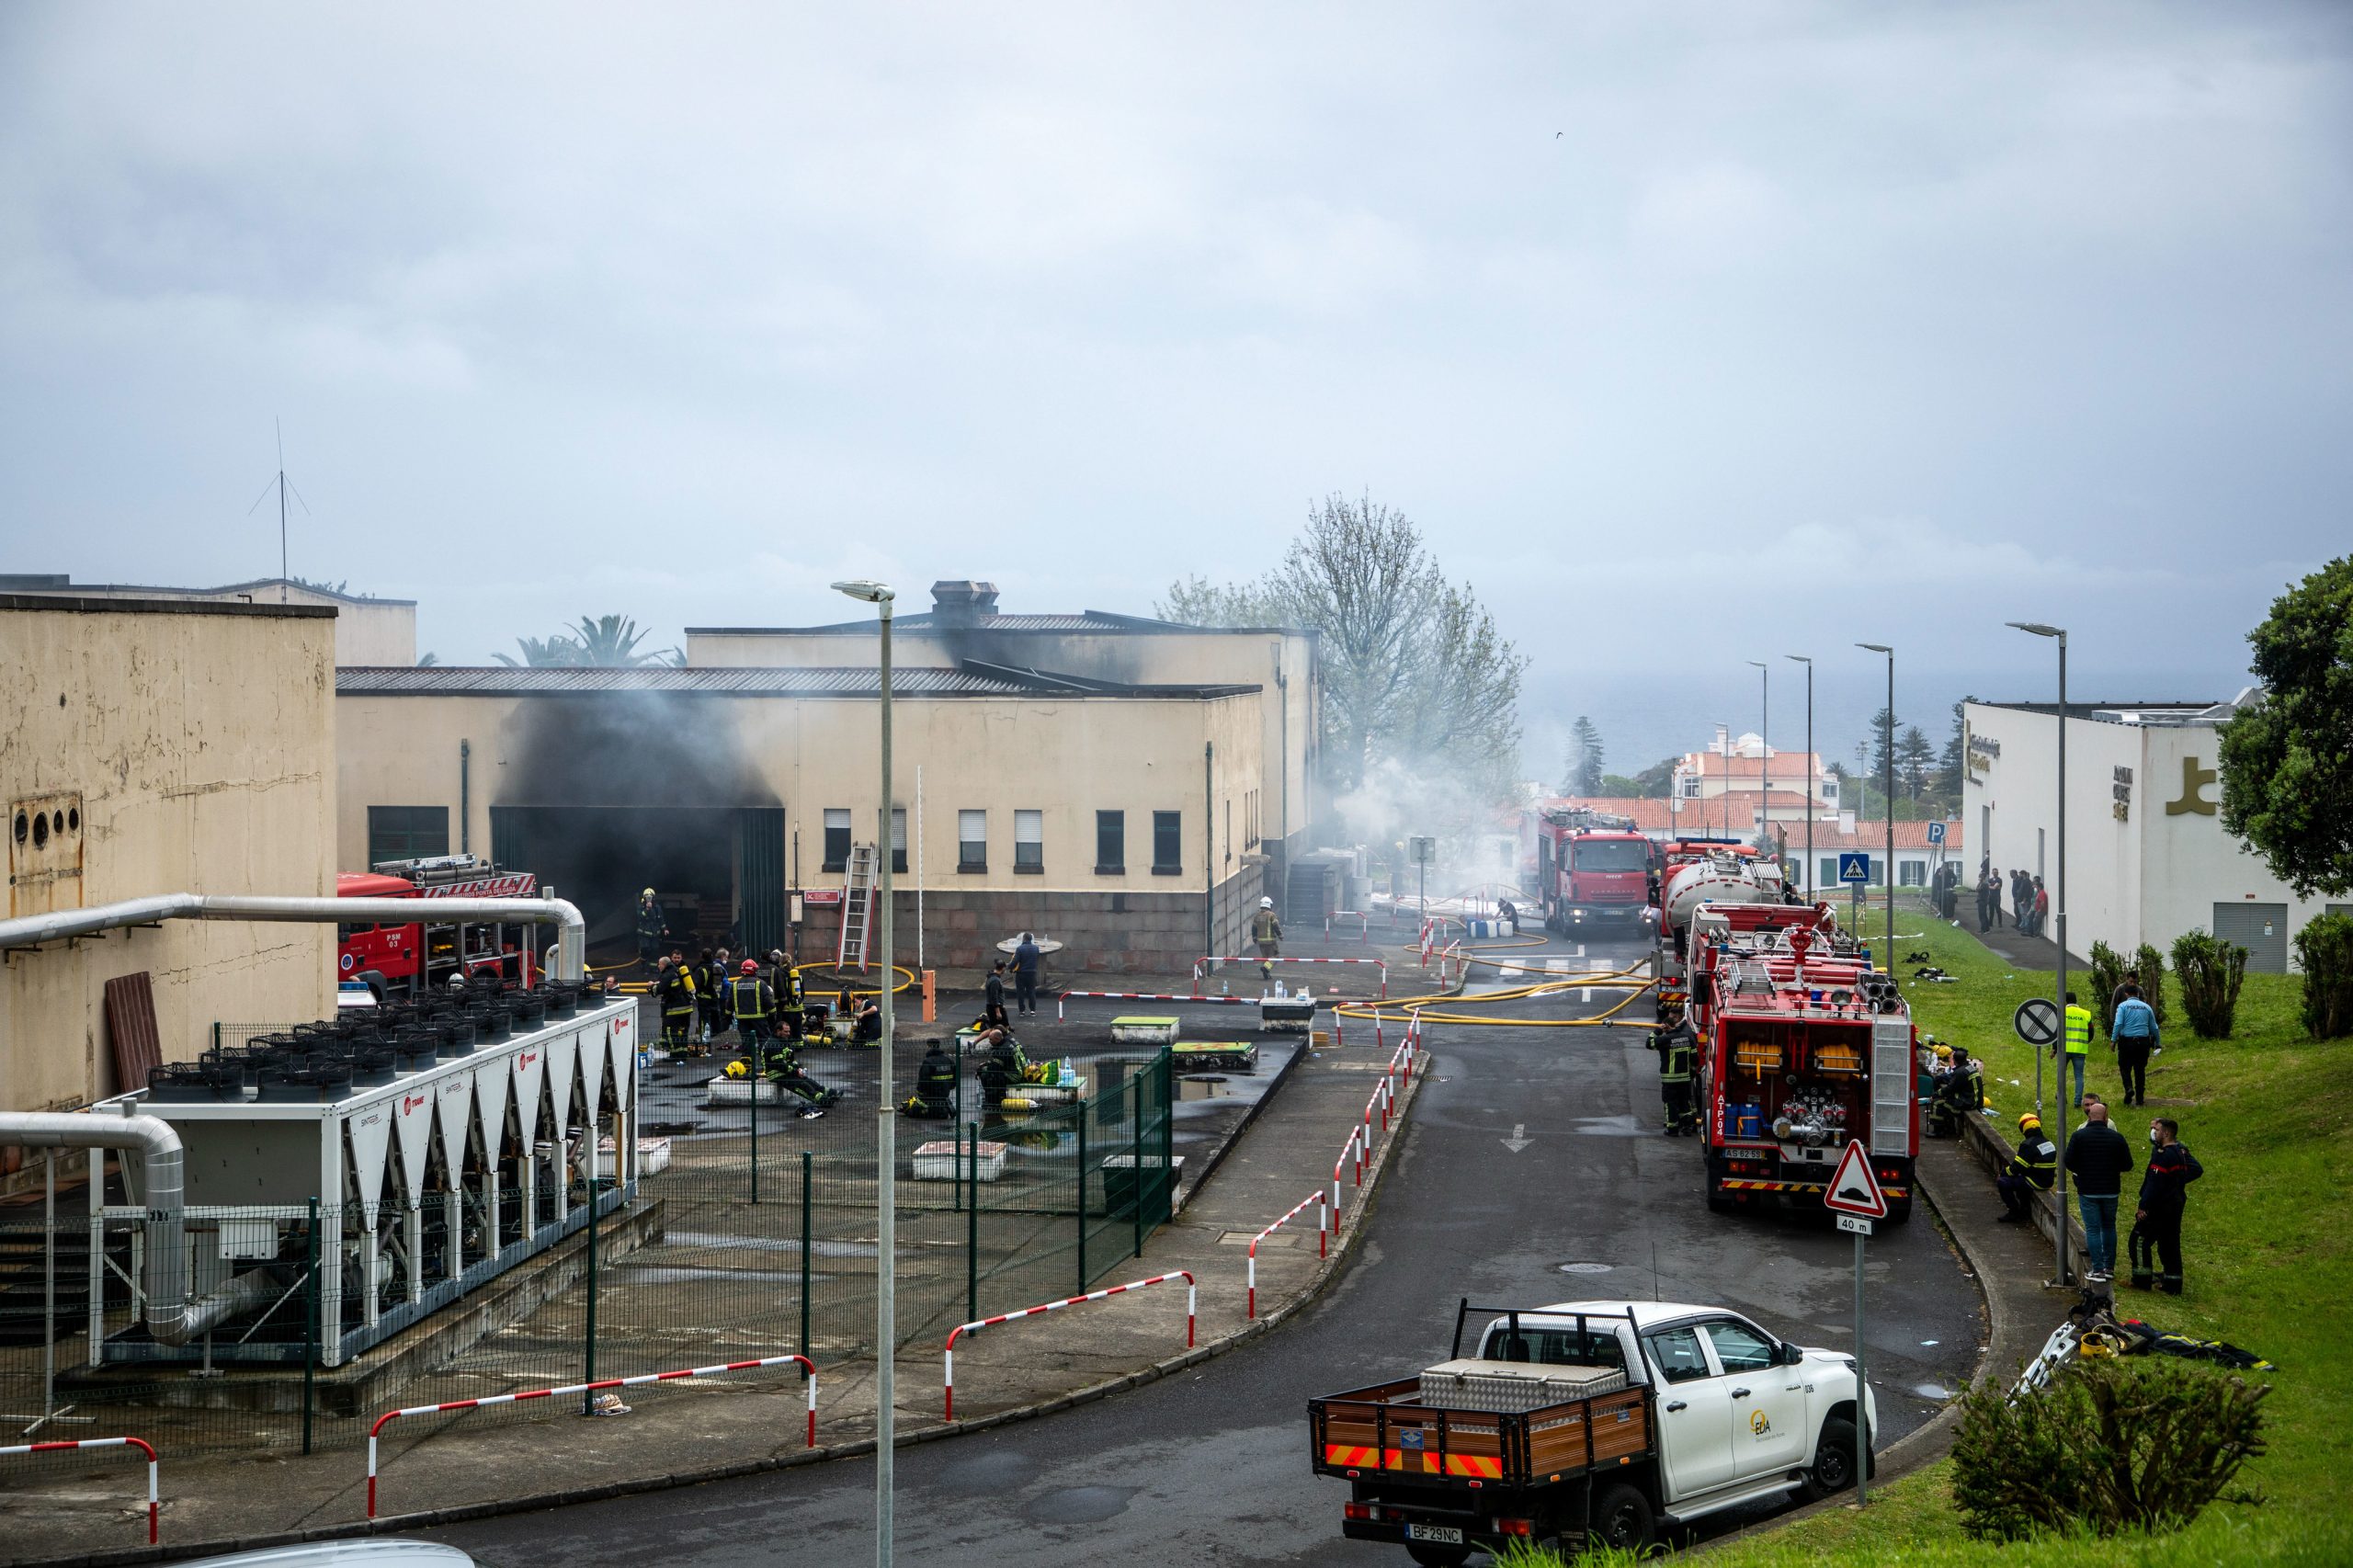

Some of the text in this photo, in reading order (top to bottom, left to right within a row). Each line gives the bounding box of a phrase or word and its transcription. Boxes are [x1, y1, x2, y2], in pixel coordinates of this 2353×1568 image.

[1931, 824, 1941, 841] P
[386, 933, 402, 941] PSM
[412, 1096, 425, 1108] TRANE
[1717, 1095, 1725, 1136] ATP-04
[1841, 1219, 1867, 1233] 40 m
[1755, 1419, 1771, 1435] EDA
[1413, 1526, 1460, 1542] BF 29 NC
